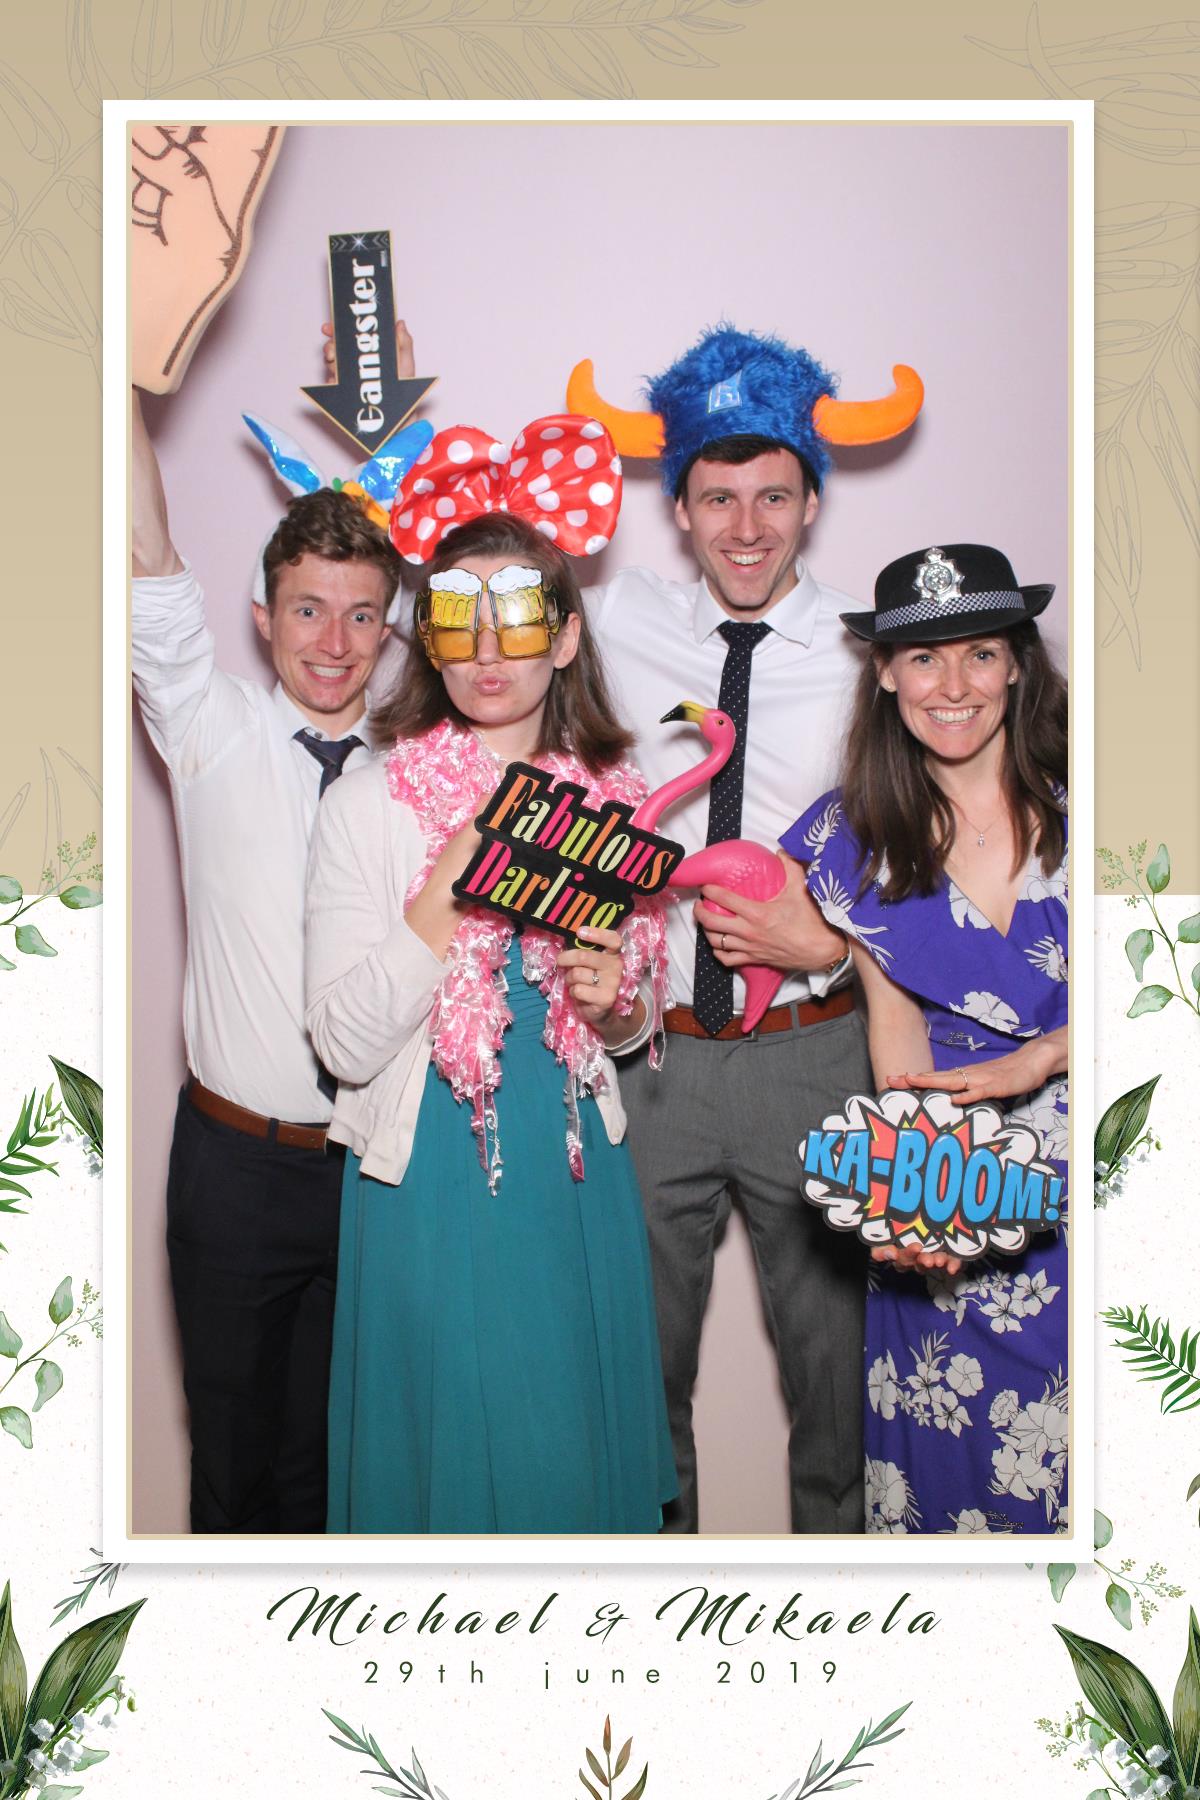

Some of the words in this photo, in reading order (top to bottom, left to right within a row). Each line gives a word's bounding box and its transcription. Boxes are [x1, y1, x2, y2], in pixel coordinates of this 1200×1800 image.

[348, 258, 385, 433] Gangster
[484, 772, 675, 889] Fabulous
[462, 839, 625, 950] Darling
[803, 1129, 1063, 1223] KA-BOOM!
